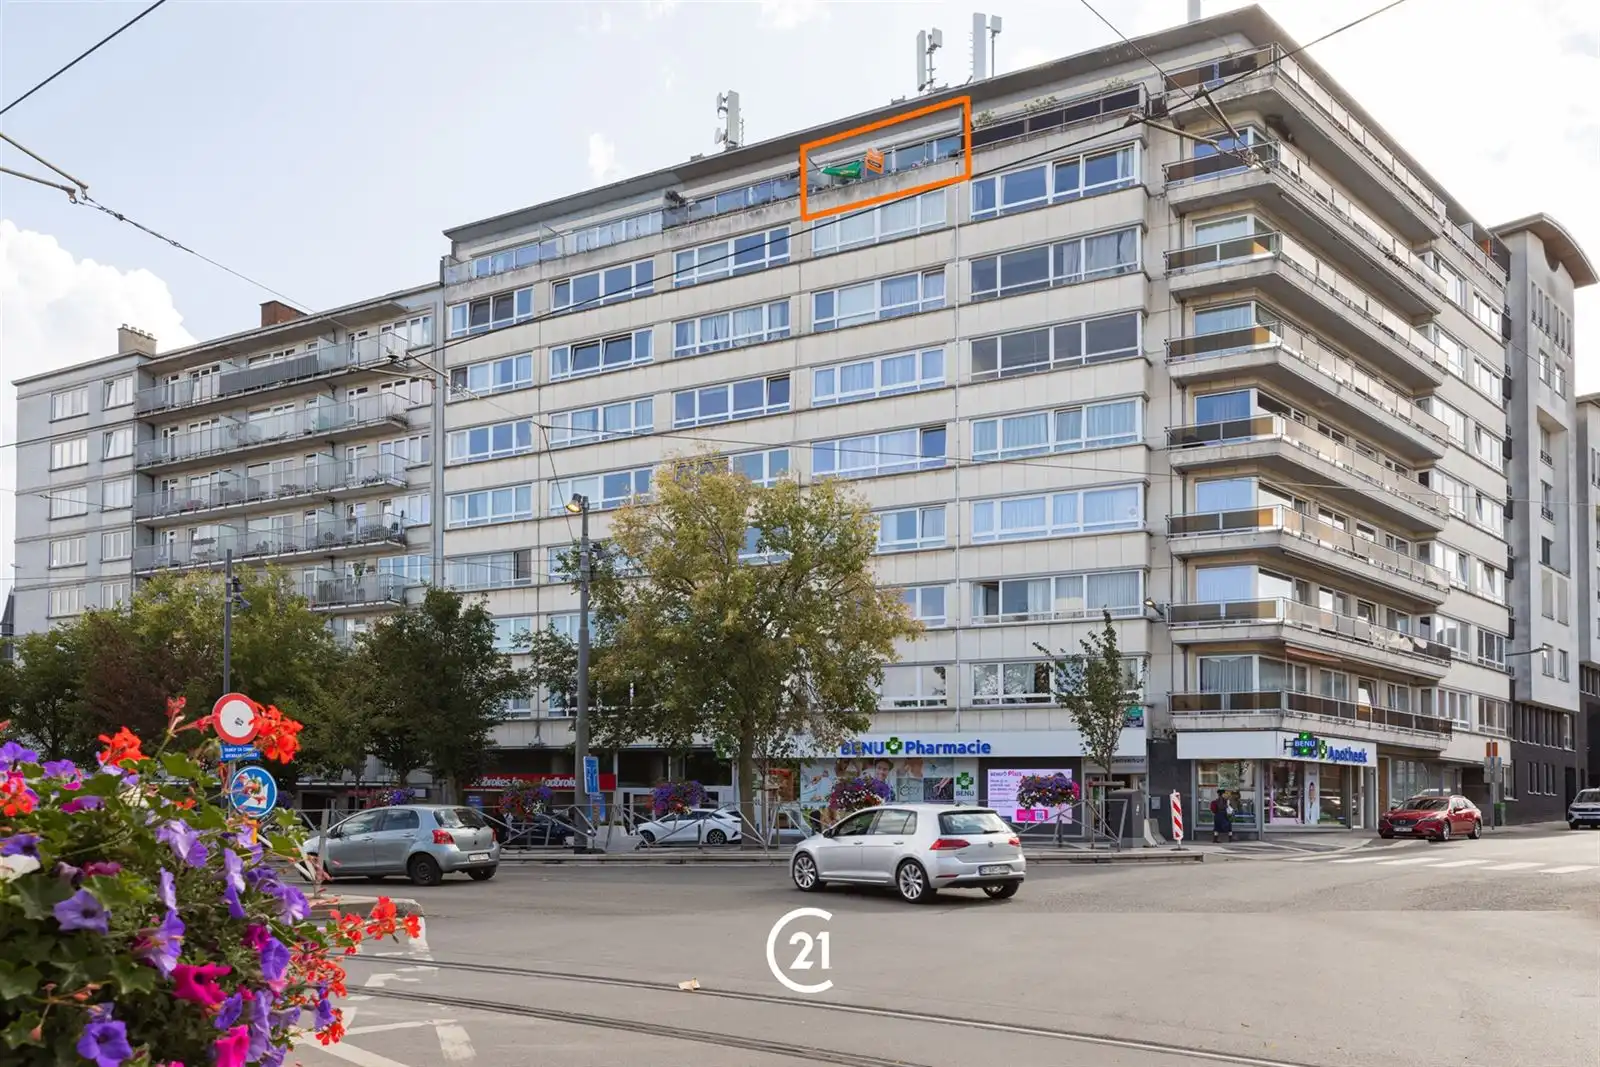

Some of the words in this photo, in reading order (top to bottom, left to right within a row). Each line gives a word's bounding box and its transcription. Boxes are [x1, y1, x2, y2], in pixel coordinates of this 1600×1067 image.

[841, 741, 884, 755] BENU
[905, 739, 991, 755] Pharmacie
[1327, 746, 1368, 763] Apotheek
